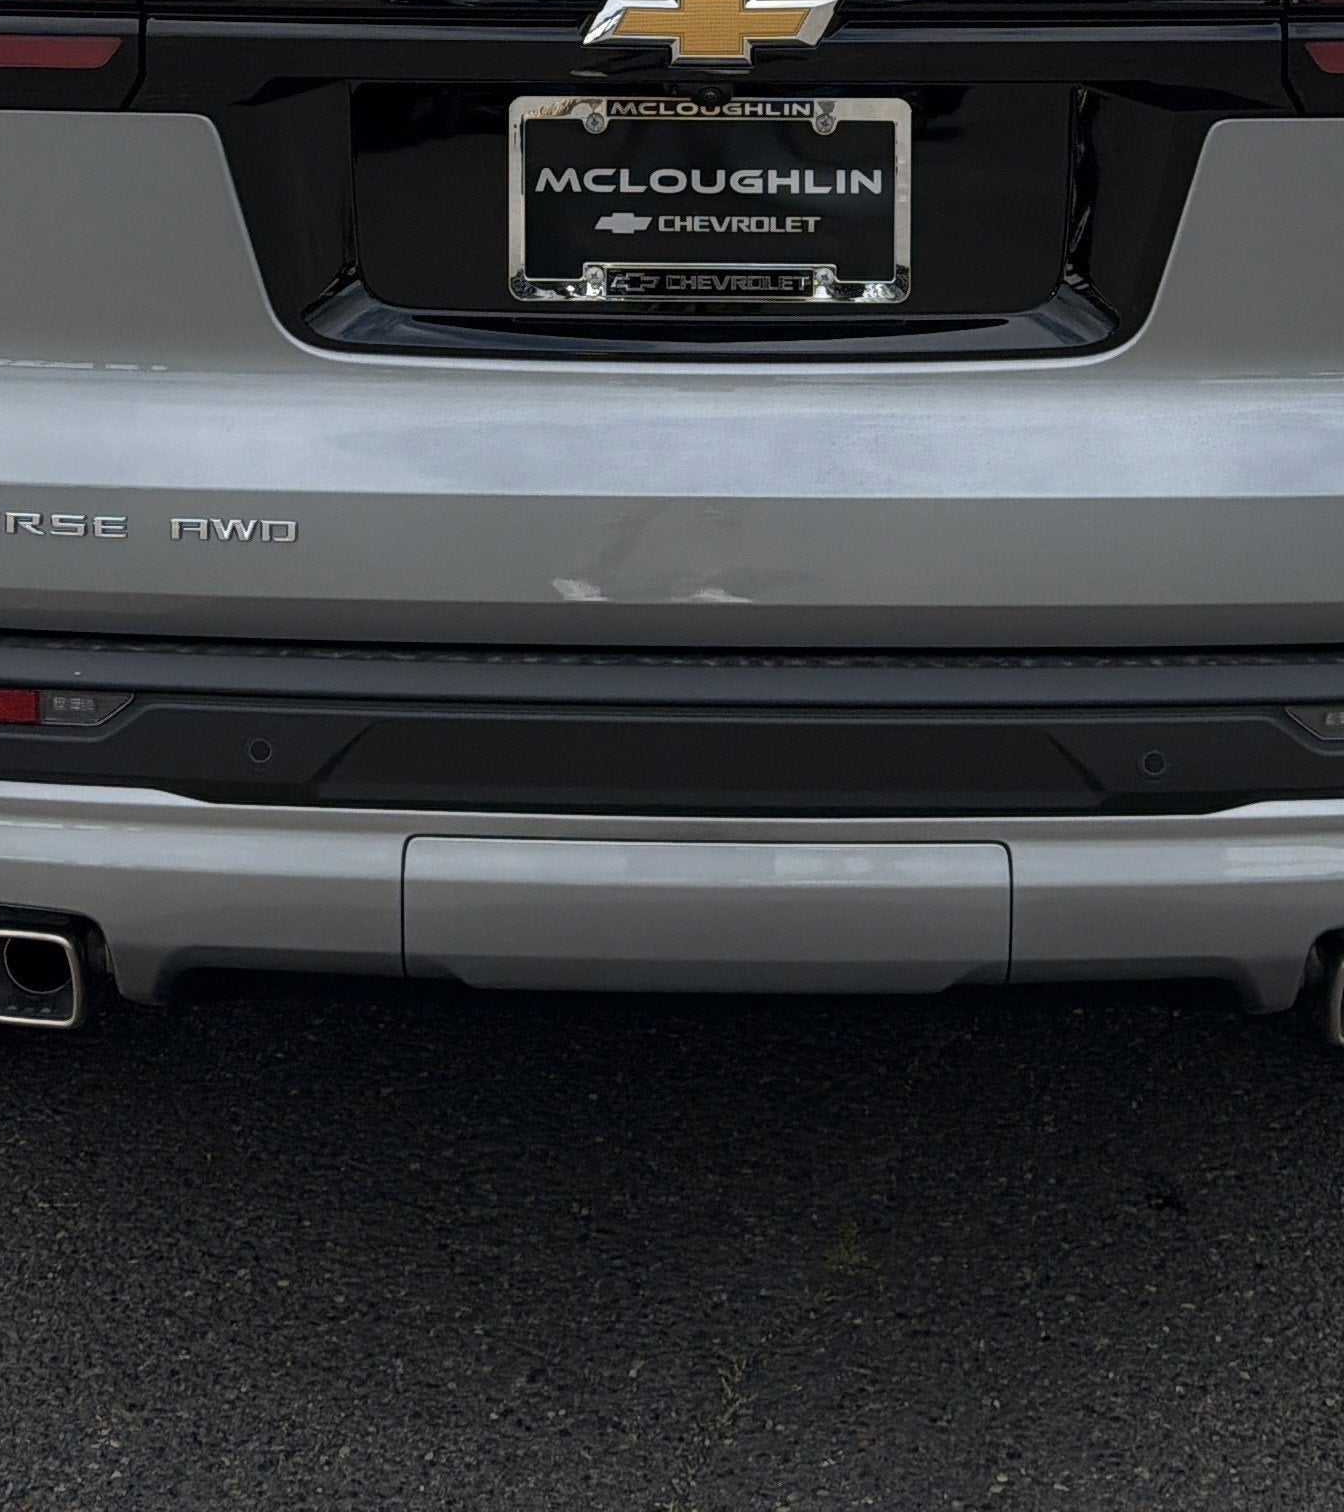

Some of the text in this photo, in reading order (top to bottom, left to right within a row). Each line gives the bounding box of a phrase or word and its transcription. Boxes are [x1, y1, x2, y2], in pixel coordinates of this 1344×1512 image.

[610, 101, 811, 116] MCLOUGHLIN
[534, 167, 883, 195] MCLOUGHLIN
[658, 215, 821, 233] CHEVROLET
[665, 274, 810, 291] CHEVROLET
[169, 517, 299, 543] AWD
